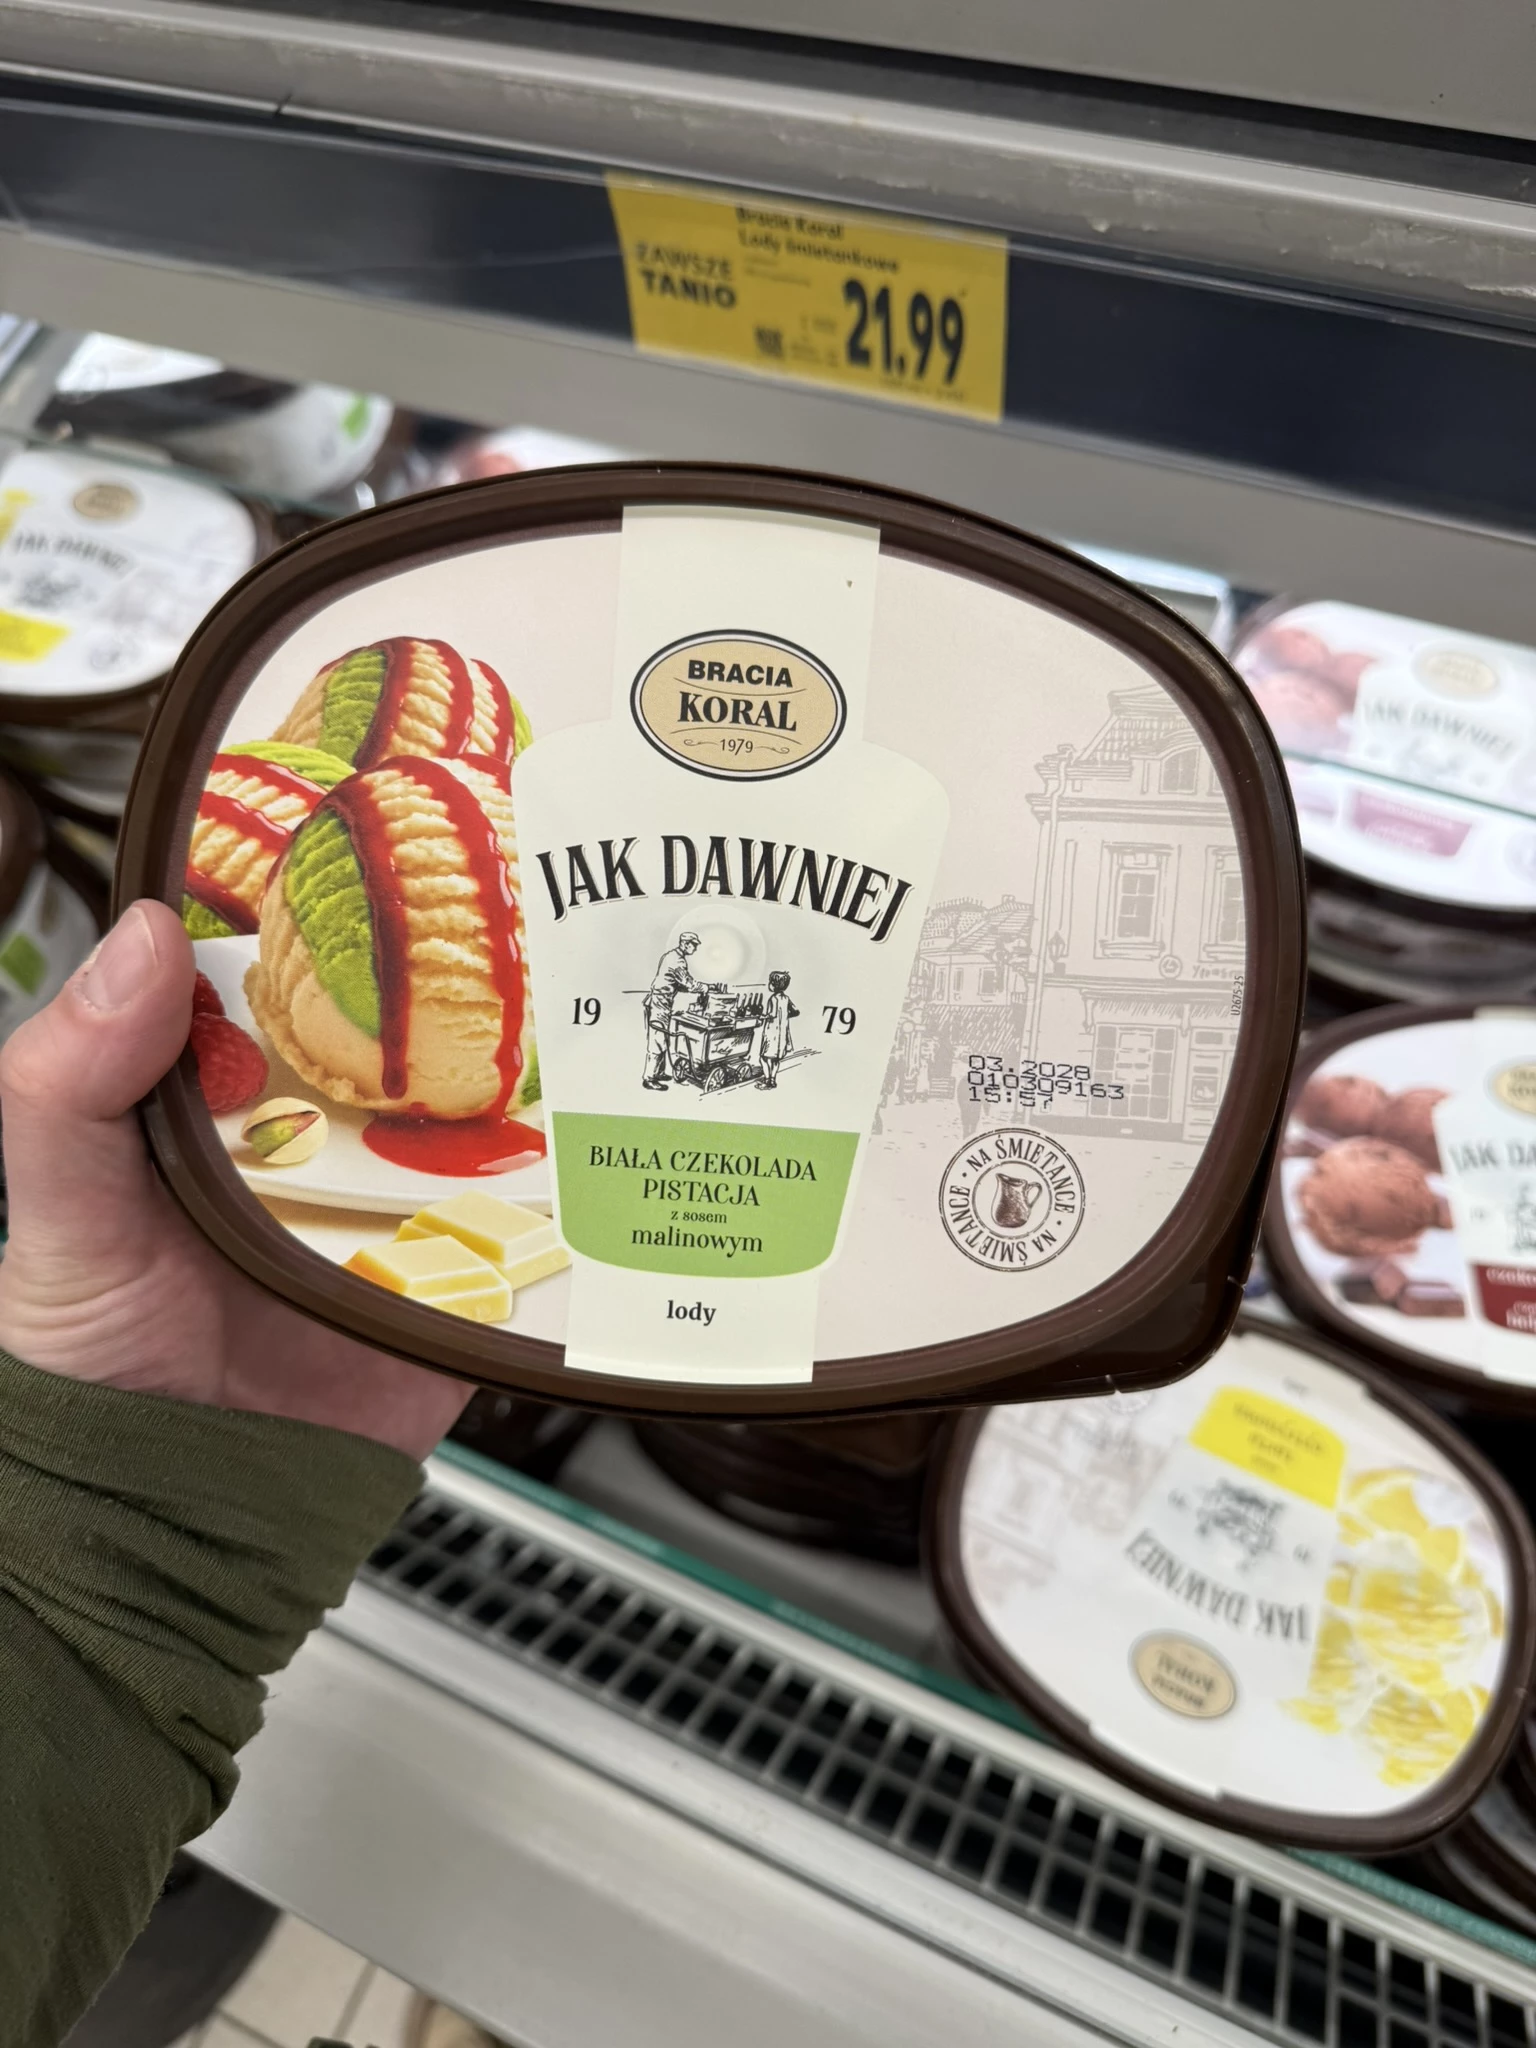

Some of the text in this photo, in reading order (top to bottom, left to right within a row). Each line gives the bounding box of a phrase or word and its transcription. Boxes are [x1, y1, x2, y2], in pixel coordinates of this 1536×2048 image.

[636, 242, 732, 280] ZAWSZE
[640, 271, 737, 309] TANIO
[843, 278, 965, 385] 21.99
[688, 660, 793, 688] BRACIA
[677, 691, 797, 732] KORAL
[719, 738, 754, 755] 1979
[536, 834, 915, 944] JAK DAWNIEJ
[571, 997, 602, 1026] 19
[1230, 975, 1244, 1016] U2675-25
[821, 1005, 857, 1035] 79
[969, 1055, 1090, 1080] 03.2028
[968, 1071, 1124, 1100] 010309163
[589, 1145, 817, 1181] BIAŁA CZEKOLADA
[966, 1133, 1076, 1215] NA ŚMIETANCE
[642, 1178, 760, 1206] PISTACJA
[670, 1210, 728, 1224] z sosem
[948, 1183, 1057, 1265] NA ŚMIETANCE
[631, 1226, 763, 1258] malinowym
[666, 1300, 716, 1326] lody
